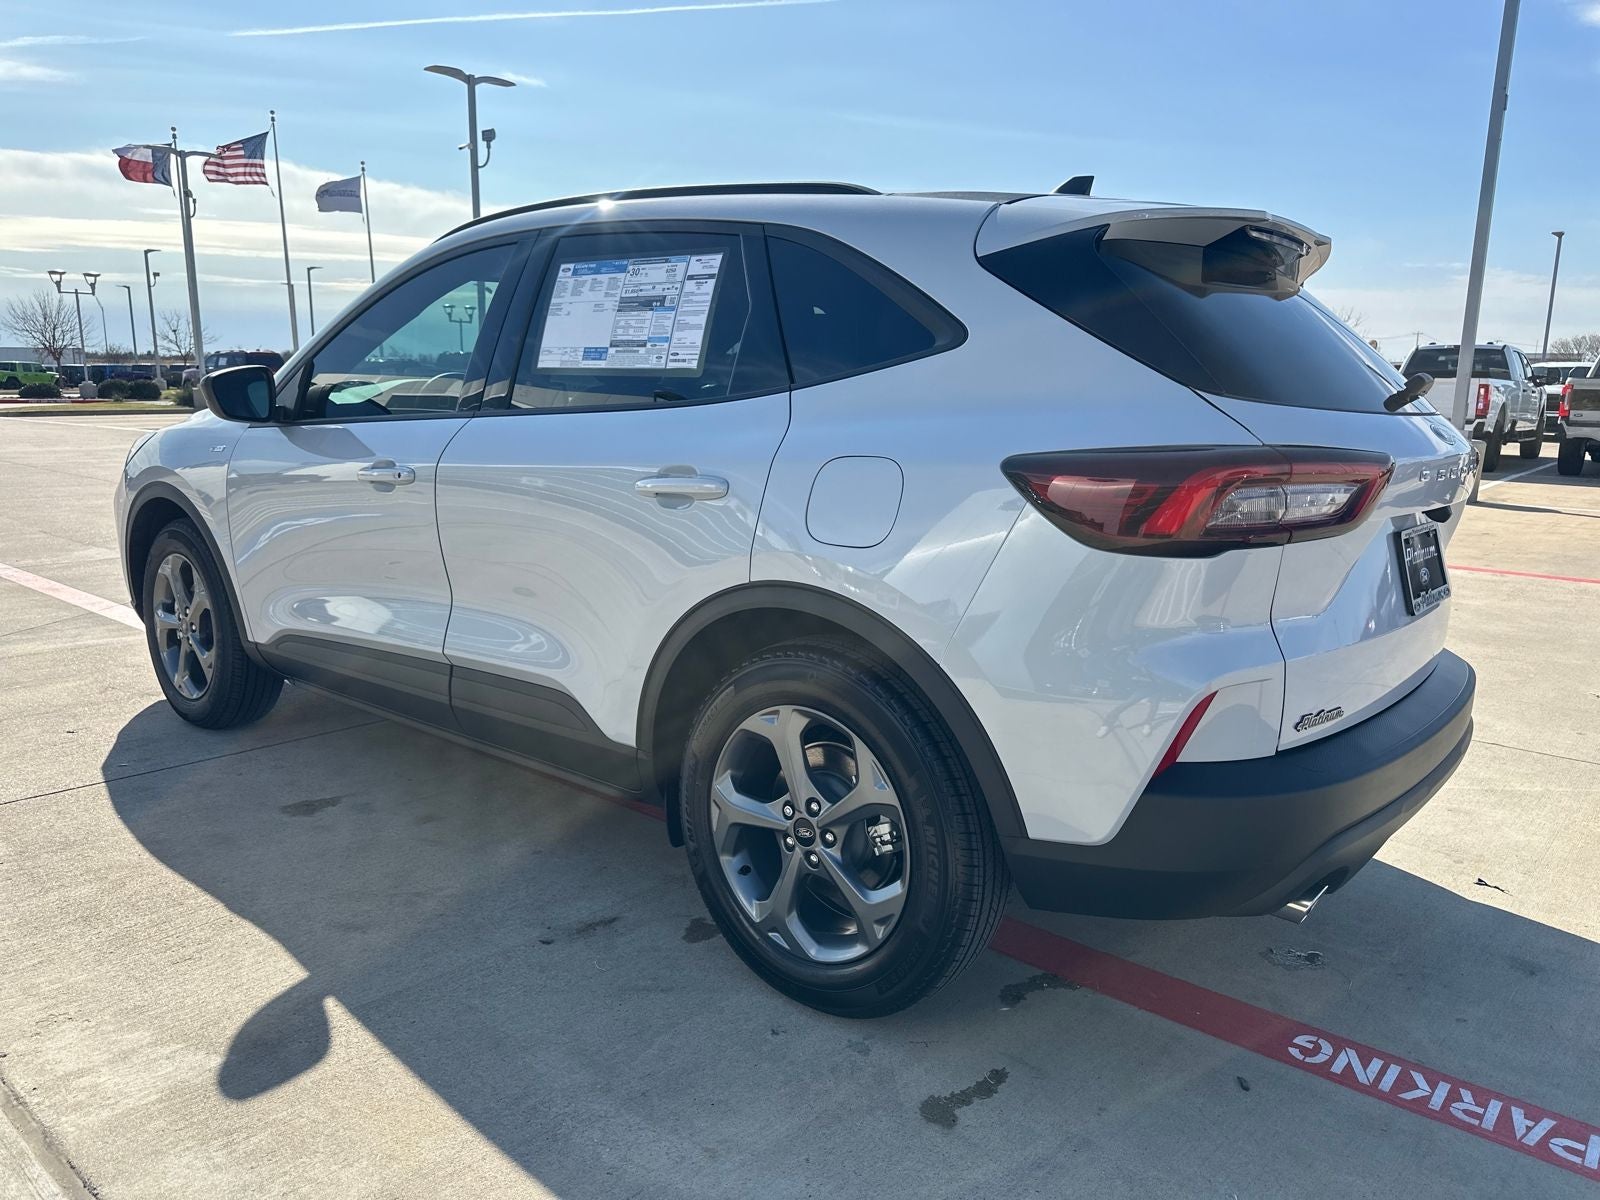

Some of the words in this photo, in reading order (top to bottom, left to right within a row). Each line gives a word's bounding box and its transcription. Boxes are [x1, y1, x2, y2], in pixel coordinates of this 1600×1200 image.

[630, 267, 640, 277] 30
[1294, 706, 1344, 732] Platinum
[1288, 1034, 1600, 1169] PARKING
